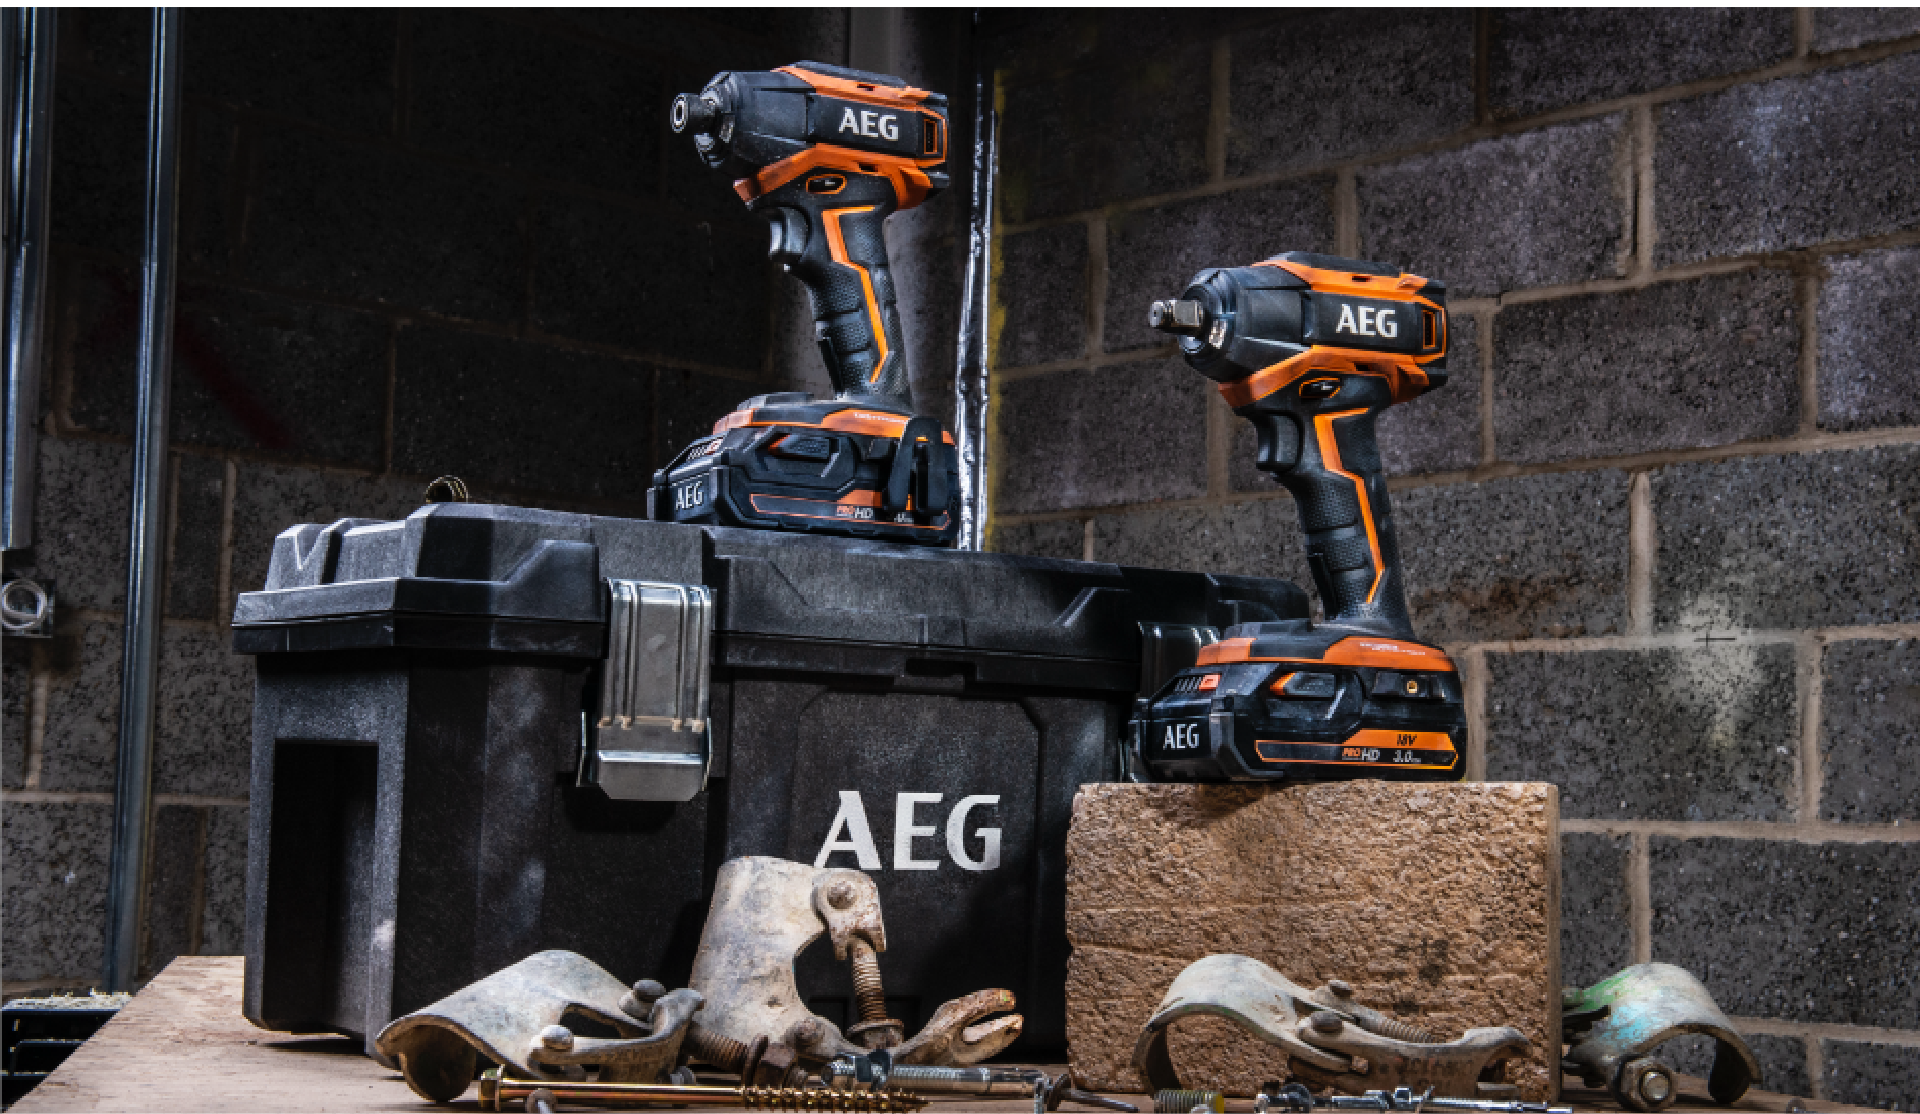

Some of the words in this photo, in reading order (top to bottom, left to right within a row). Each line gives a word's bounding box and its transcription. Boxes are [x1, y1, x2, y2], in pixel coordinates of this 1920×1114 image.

[839, 106, 899, 141] AEG
[1336, 303, 1398, 339] AEG
[675, 481, 703, 511] AEG
[1162, 722, 1200, 750] AEG
[1361, 747, 1380, 762] HD
[813, 790, 1002, 871] AEG
